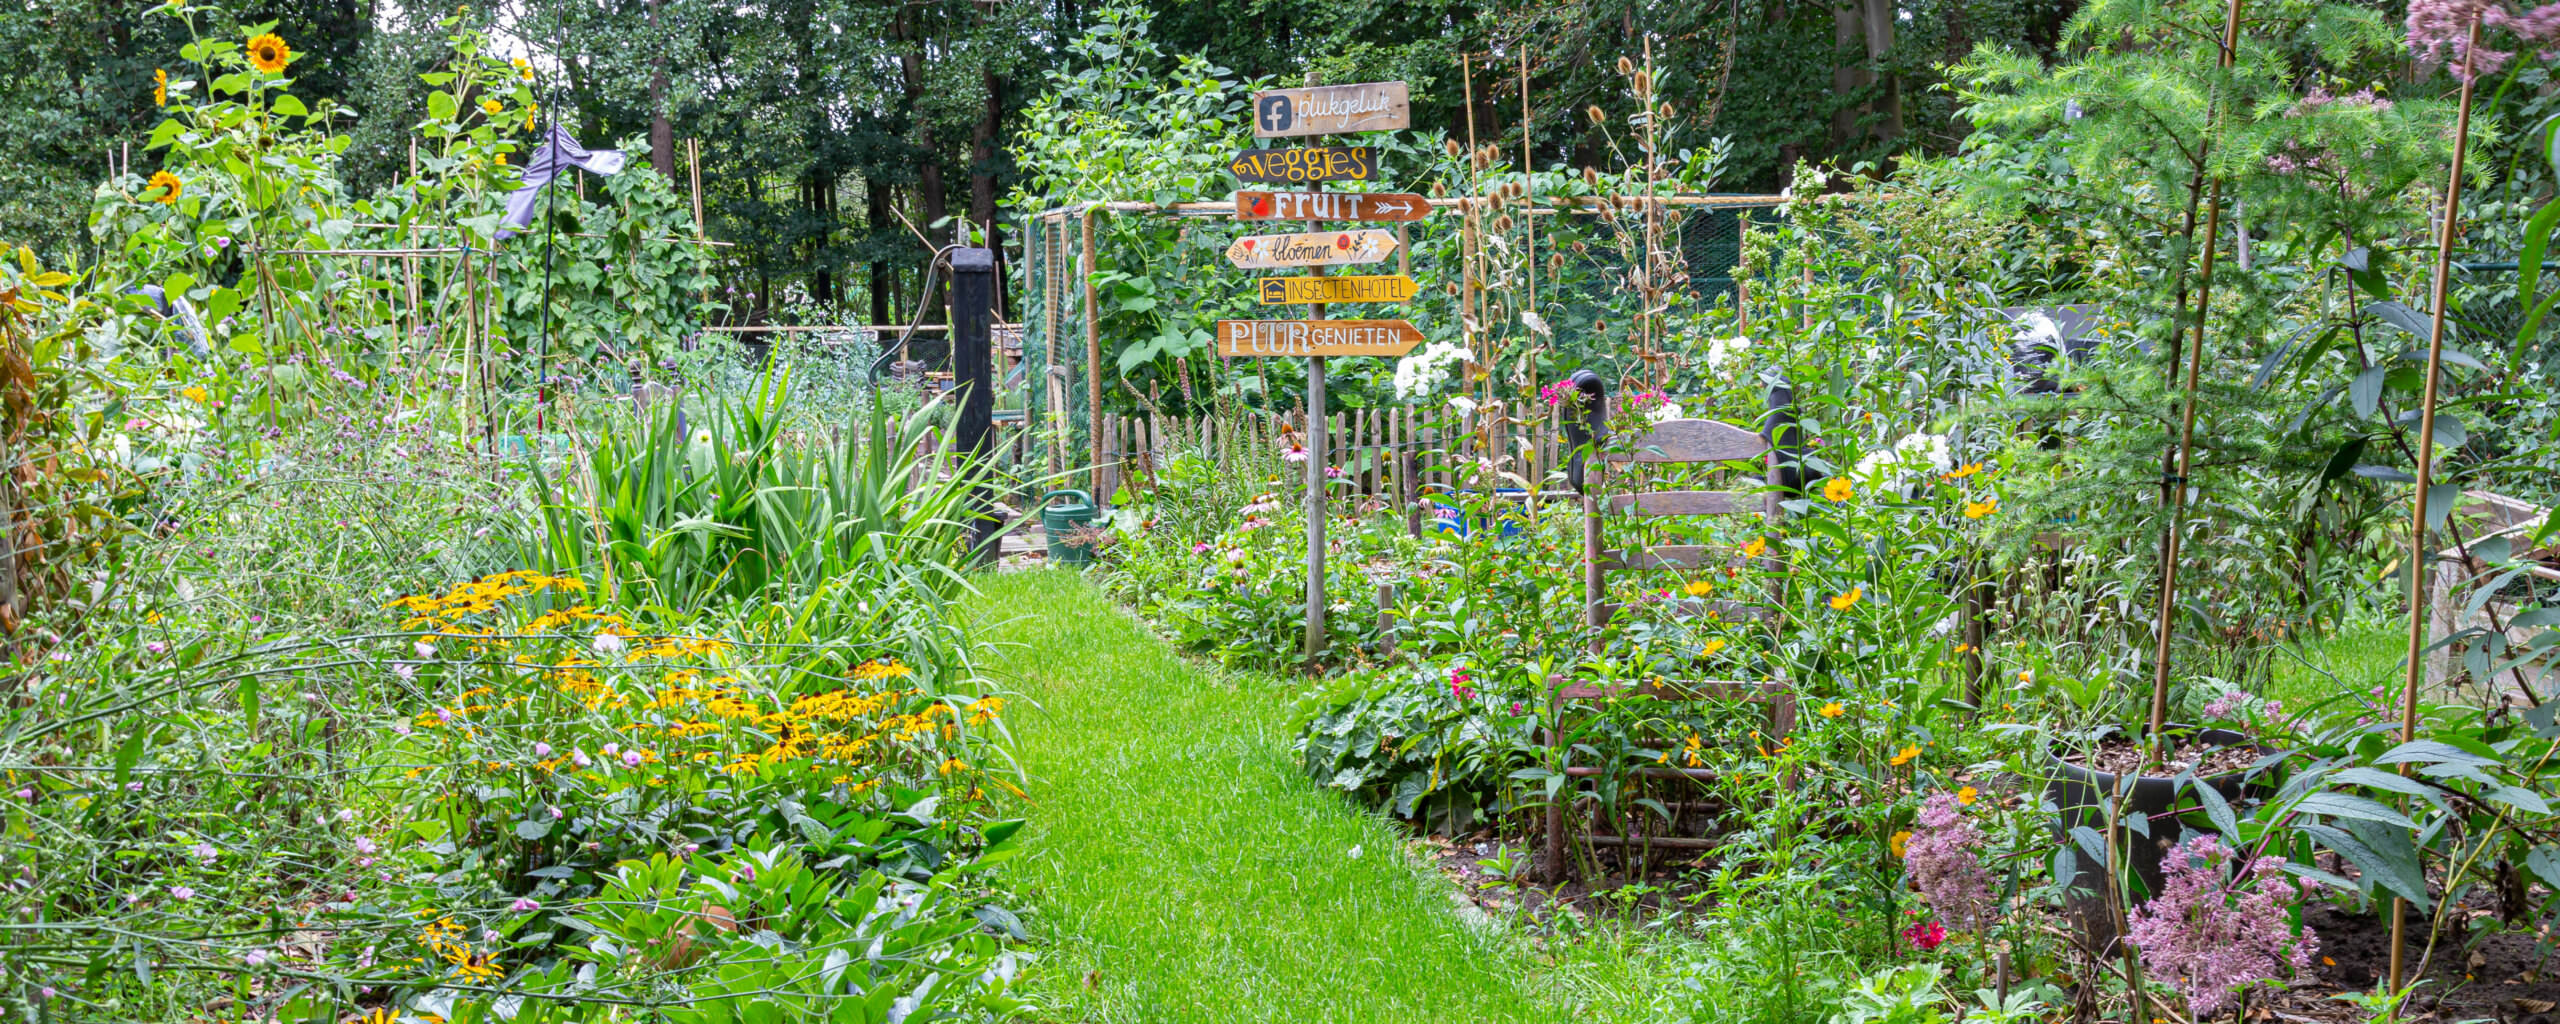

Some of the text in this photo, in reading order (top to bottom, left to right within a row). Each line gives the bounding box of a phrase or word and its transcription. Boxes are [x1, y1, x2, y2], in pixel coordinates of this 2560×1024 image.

[1297, 90, 1391, 129] plukgeluk
[1272, 236, 1333, 262] bloemen
[1288, 278, 1406, 301] INSECTENHOTEL
[1228, 322, 1401, 354] PUUR GENIETEN
